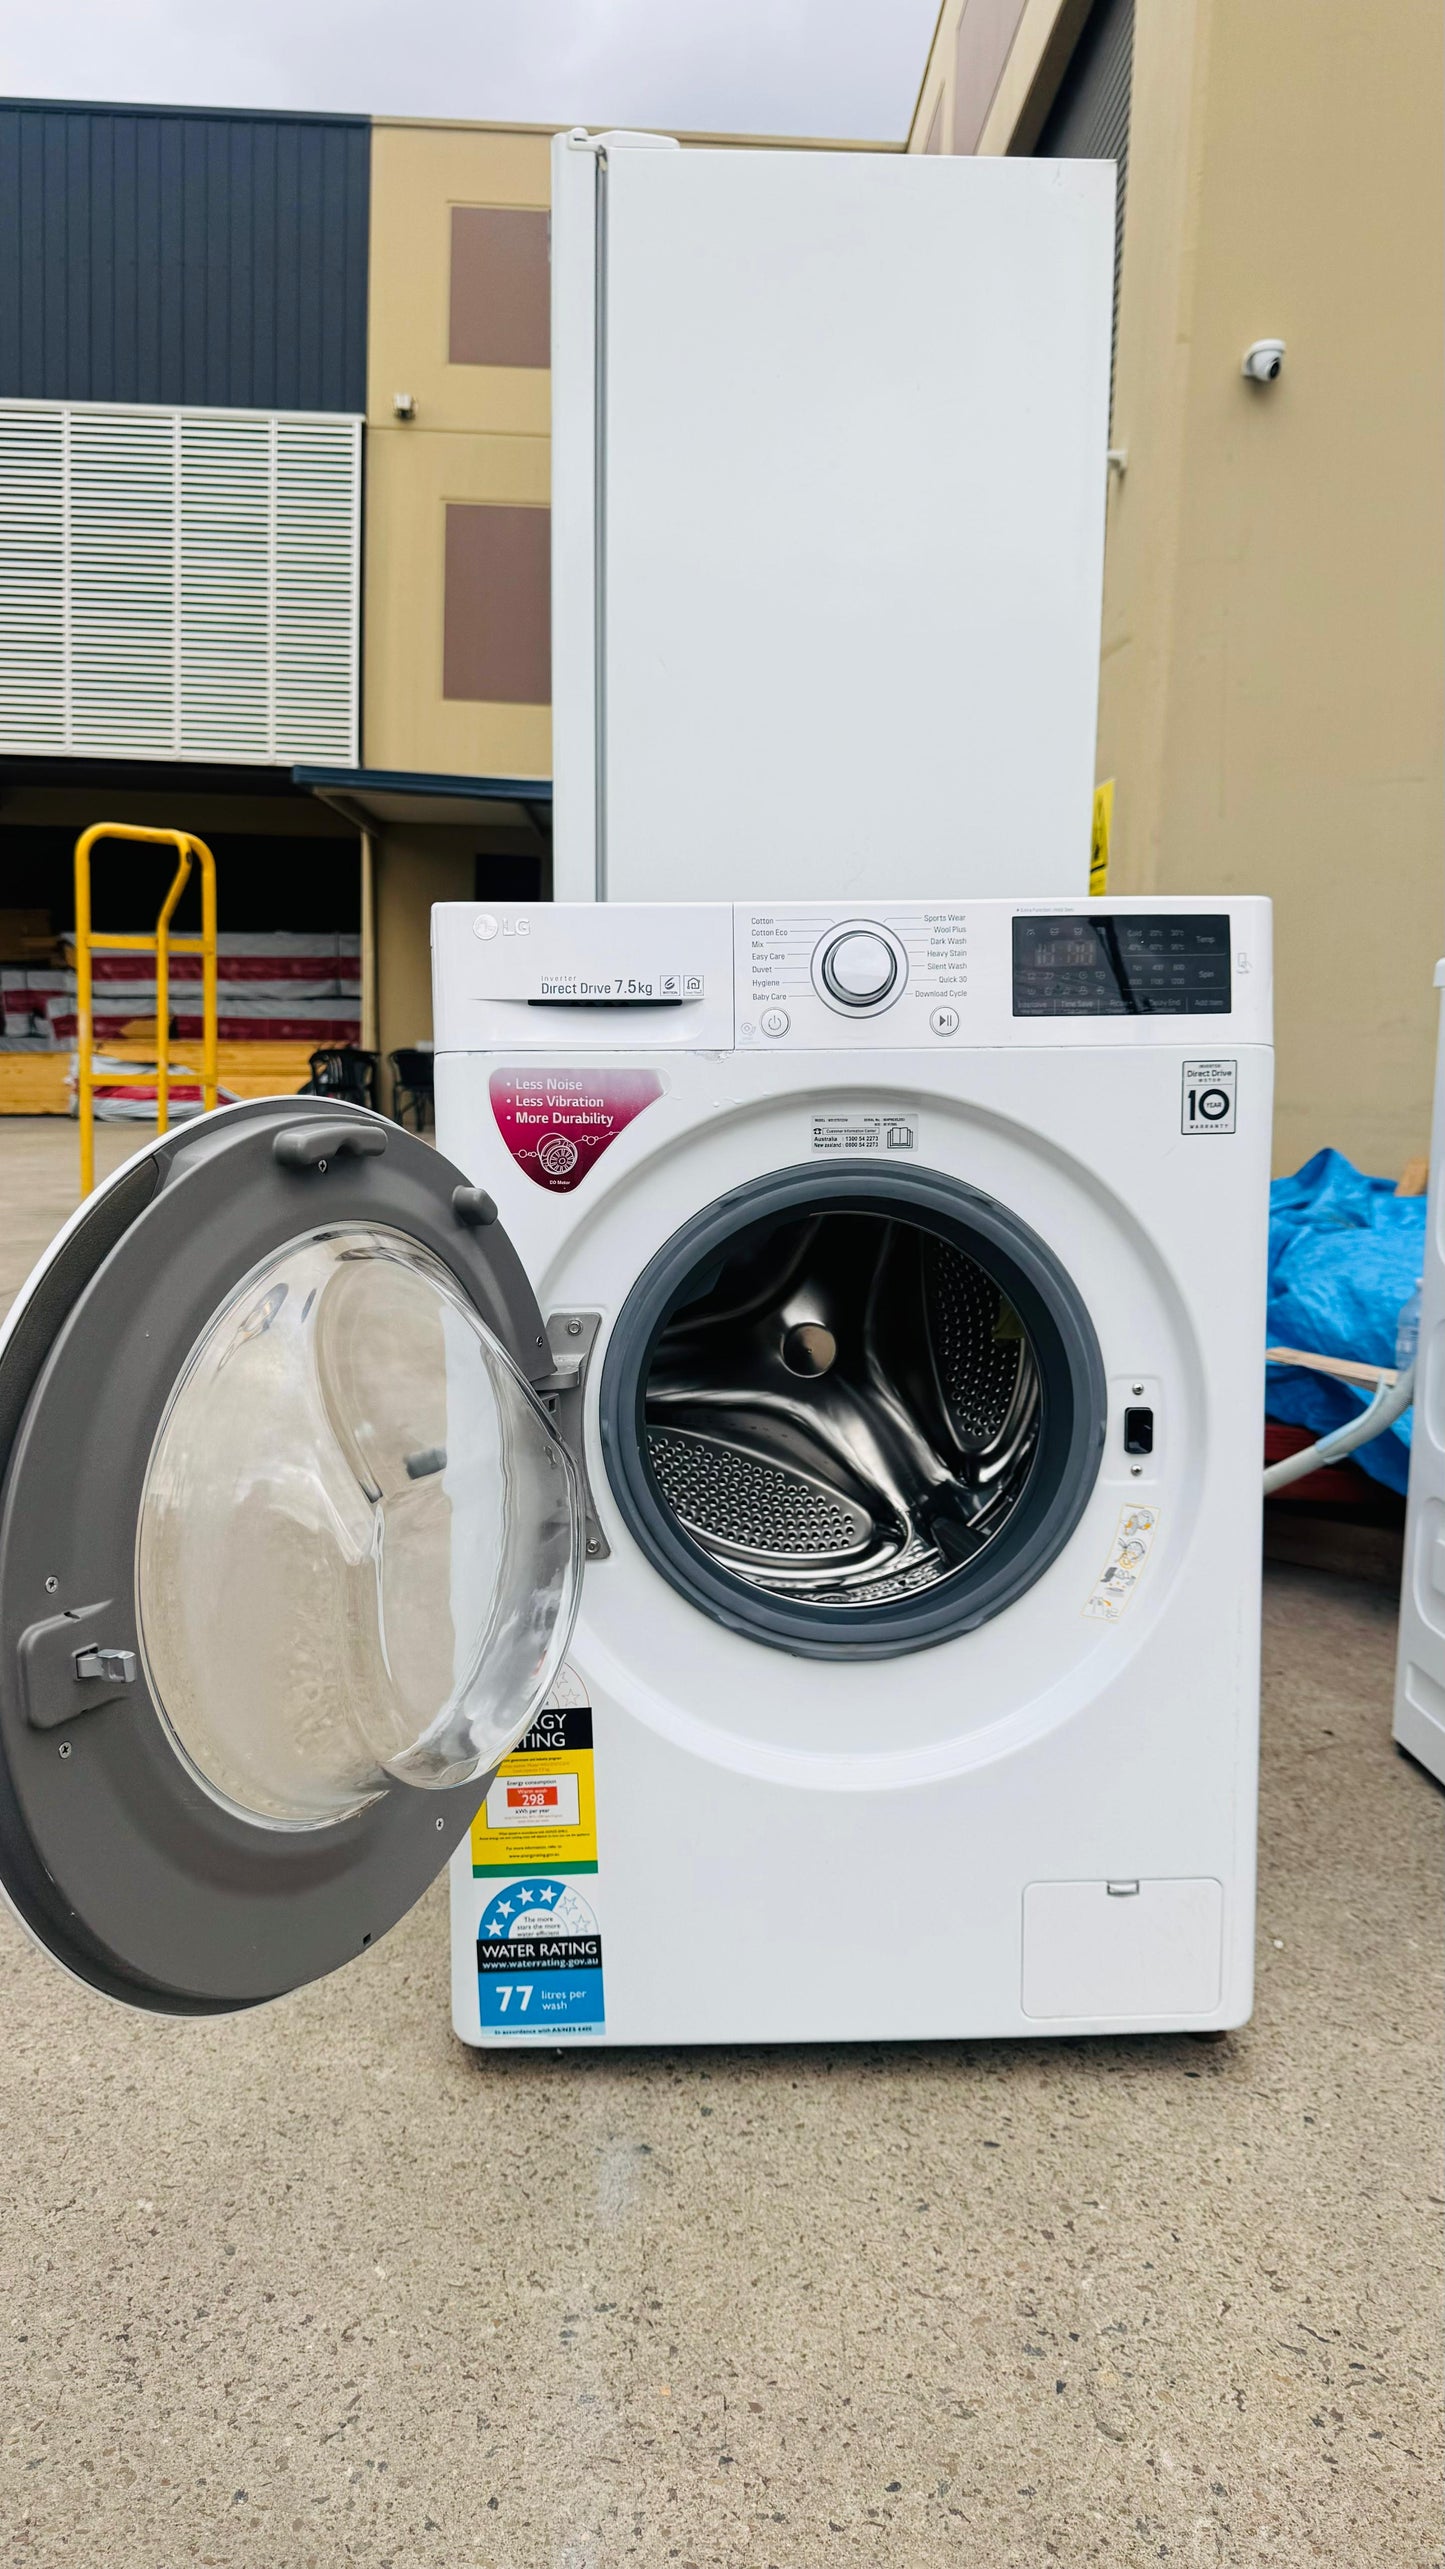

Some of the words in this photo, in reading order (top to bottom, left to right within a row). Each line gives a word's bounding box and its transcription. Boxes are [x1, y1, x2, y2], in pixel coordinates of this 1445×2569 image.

[751, 917, 774, 925] Cotton
[924, 914, 947, 923] Sports
[948, 914, 966, 922] Wear
[503, 918, 531, 936] LG
[952, 925, 967, 933] Plus
[751, 929, 773, 937] Cotton
[752, 940, 764, 948] Mix
[948, 937, 967, 945] Wash
[752, 953, 768, 961] Easy
[769, 952, 786, 960] Care
[927, 950, 947, 959] Heavy
[948, 949, 967, 957] Stain
[927, 962, 947, 970] Silent
[948, 962, 967, 970] Wash
[752, 979, 780, 988] Hygiene
[939, 976, 957, 984] Quick
[541, 982, 577, 995] Direct
[580, 981, 611, 995] Drive
[752, 993, 769, 1002] Baby
[952, 989, 968, 998] Cycle
[515, 1078, 543, 1090] Less
[547, 1078, 583, 1090] Noise
[515, 1095, 543, 1107] Less
[547, 1095, 604, 1108] Vibration
[1188, 1088, 1230, 1121] 10
[515, 1112, 549, 1124] More
[553, 1112, 614, 1127] Durability
[516, 1732, 566, 1749] TING
[522, 1794, 545, 1806] 298
[482, 1944, 536, 1958] WATER
[540, 1941, 597, 1957] RATING
[482, 1957, 599, 1970] www.waterrating.gov.au
[496, 1985, 534, 2013] 77
[541, 1990, 567, 2000] litres
[569, 1990, 587, 2001] per
[542, 2001, 568, 2011] wash
